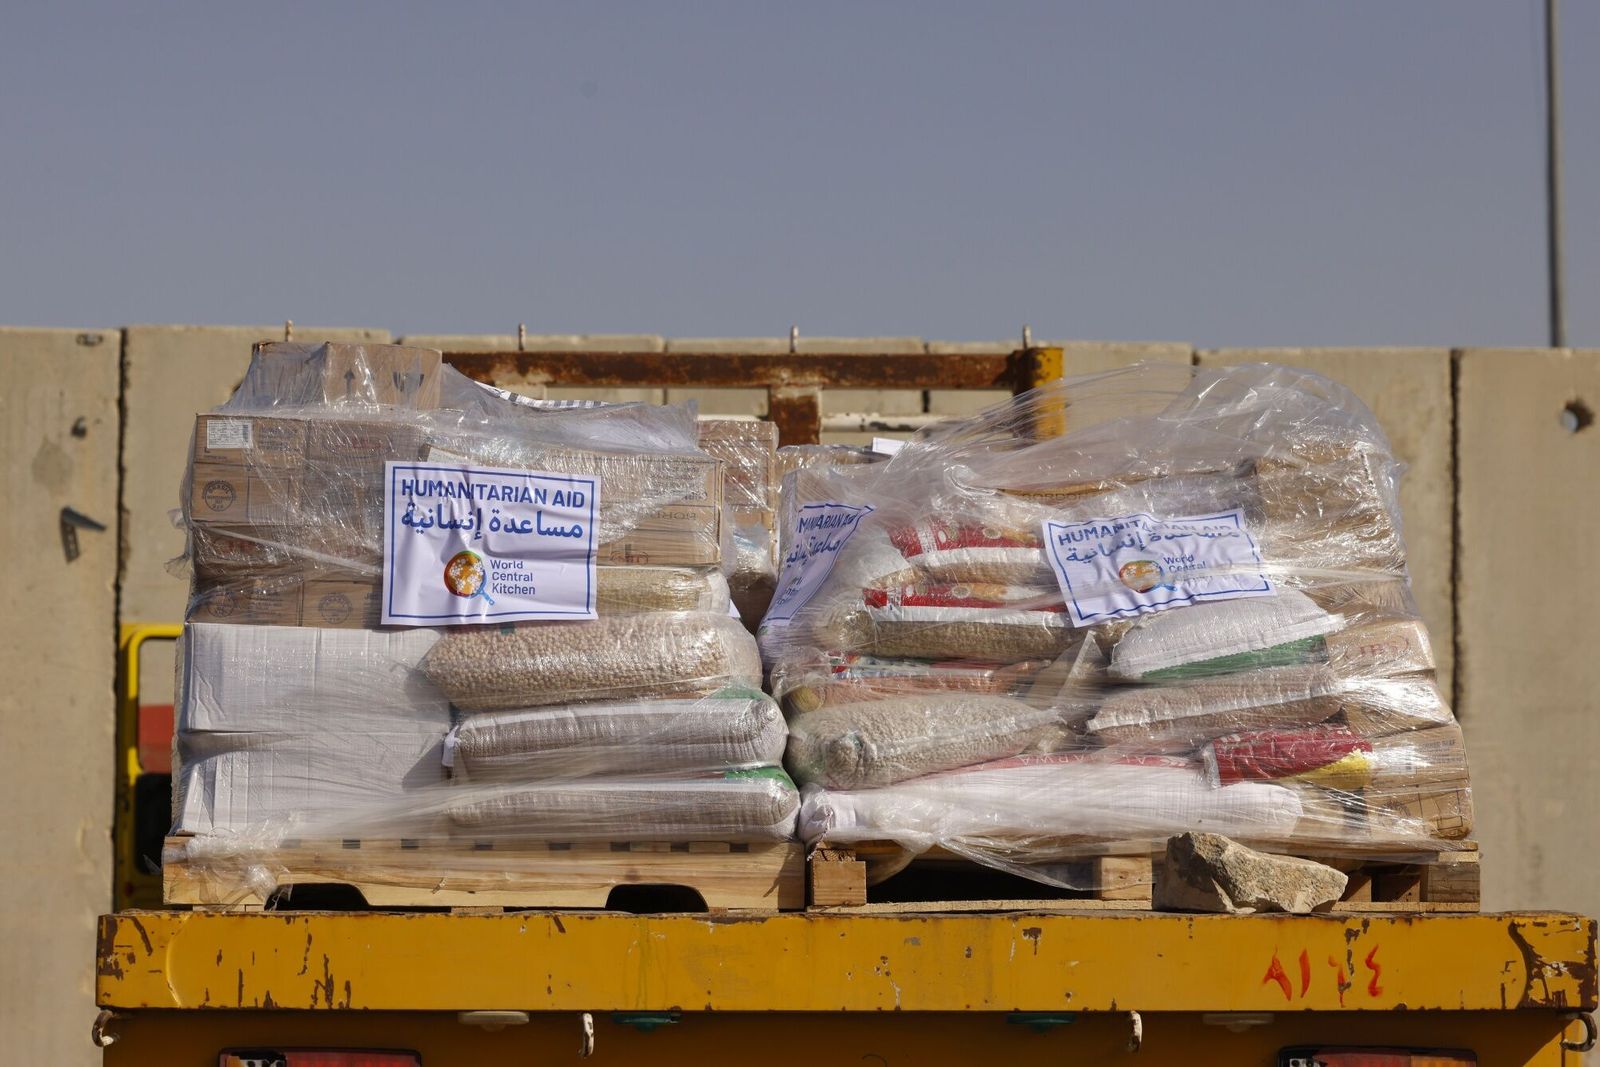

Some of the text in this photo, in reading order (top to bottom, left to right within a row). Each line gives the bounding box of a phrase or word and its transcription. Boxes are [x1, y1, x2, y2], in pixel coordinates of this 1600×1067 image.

[401, 478, 585, 508] HUMANITARIAN AID
[400, 502, 584, 540] مساعدة إنسانية
[1057, 519, 1197, 546] HUMANITARIAN
[1066, 531, 1147, 563] إنسانية
[490, 559, 524, 570] World
[491, 571, 533, 582] Central
[492, 583, 536, 595] Kitchen
